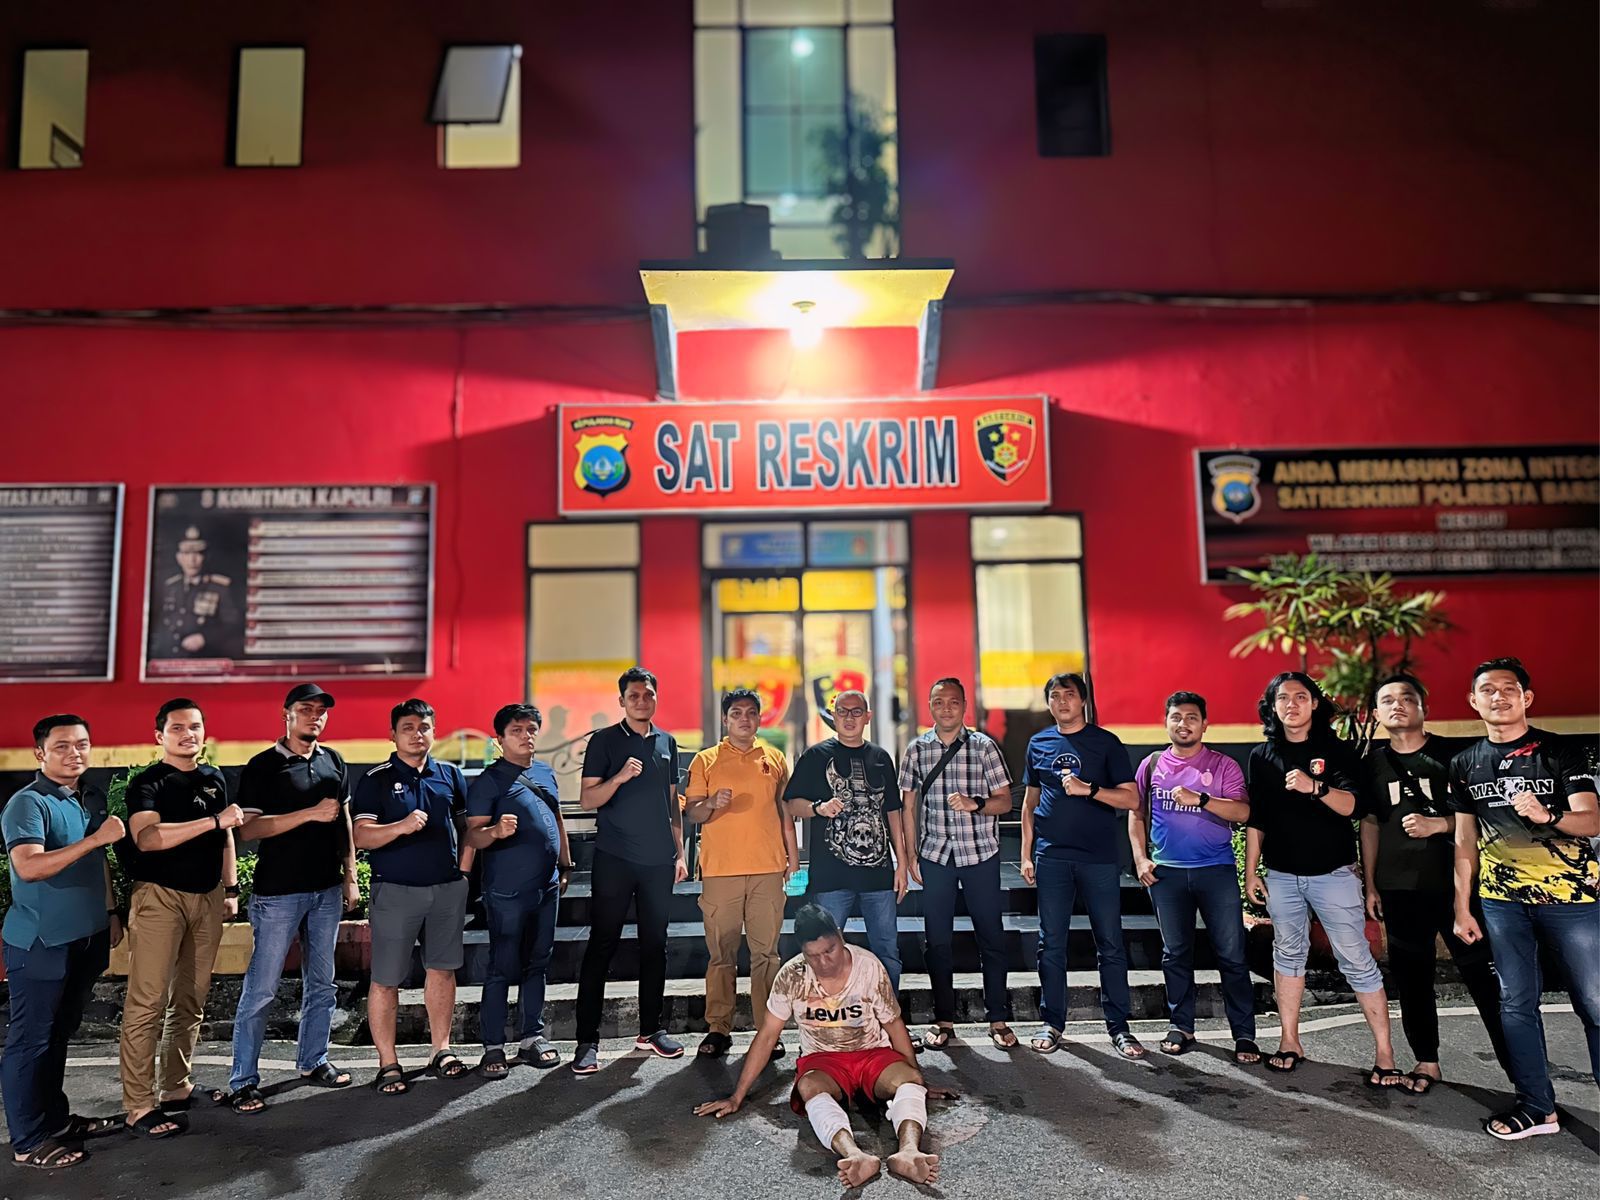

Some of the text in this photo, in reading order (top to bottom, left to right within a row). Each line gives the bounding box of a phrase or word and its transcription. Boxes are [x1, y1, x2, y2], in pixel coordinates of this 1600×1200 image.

[655, 416, 960, 492] SAT RESKRIM
[1162, 800, 1174, 811] FLY
